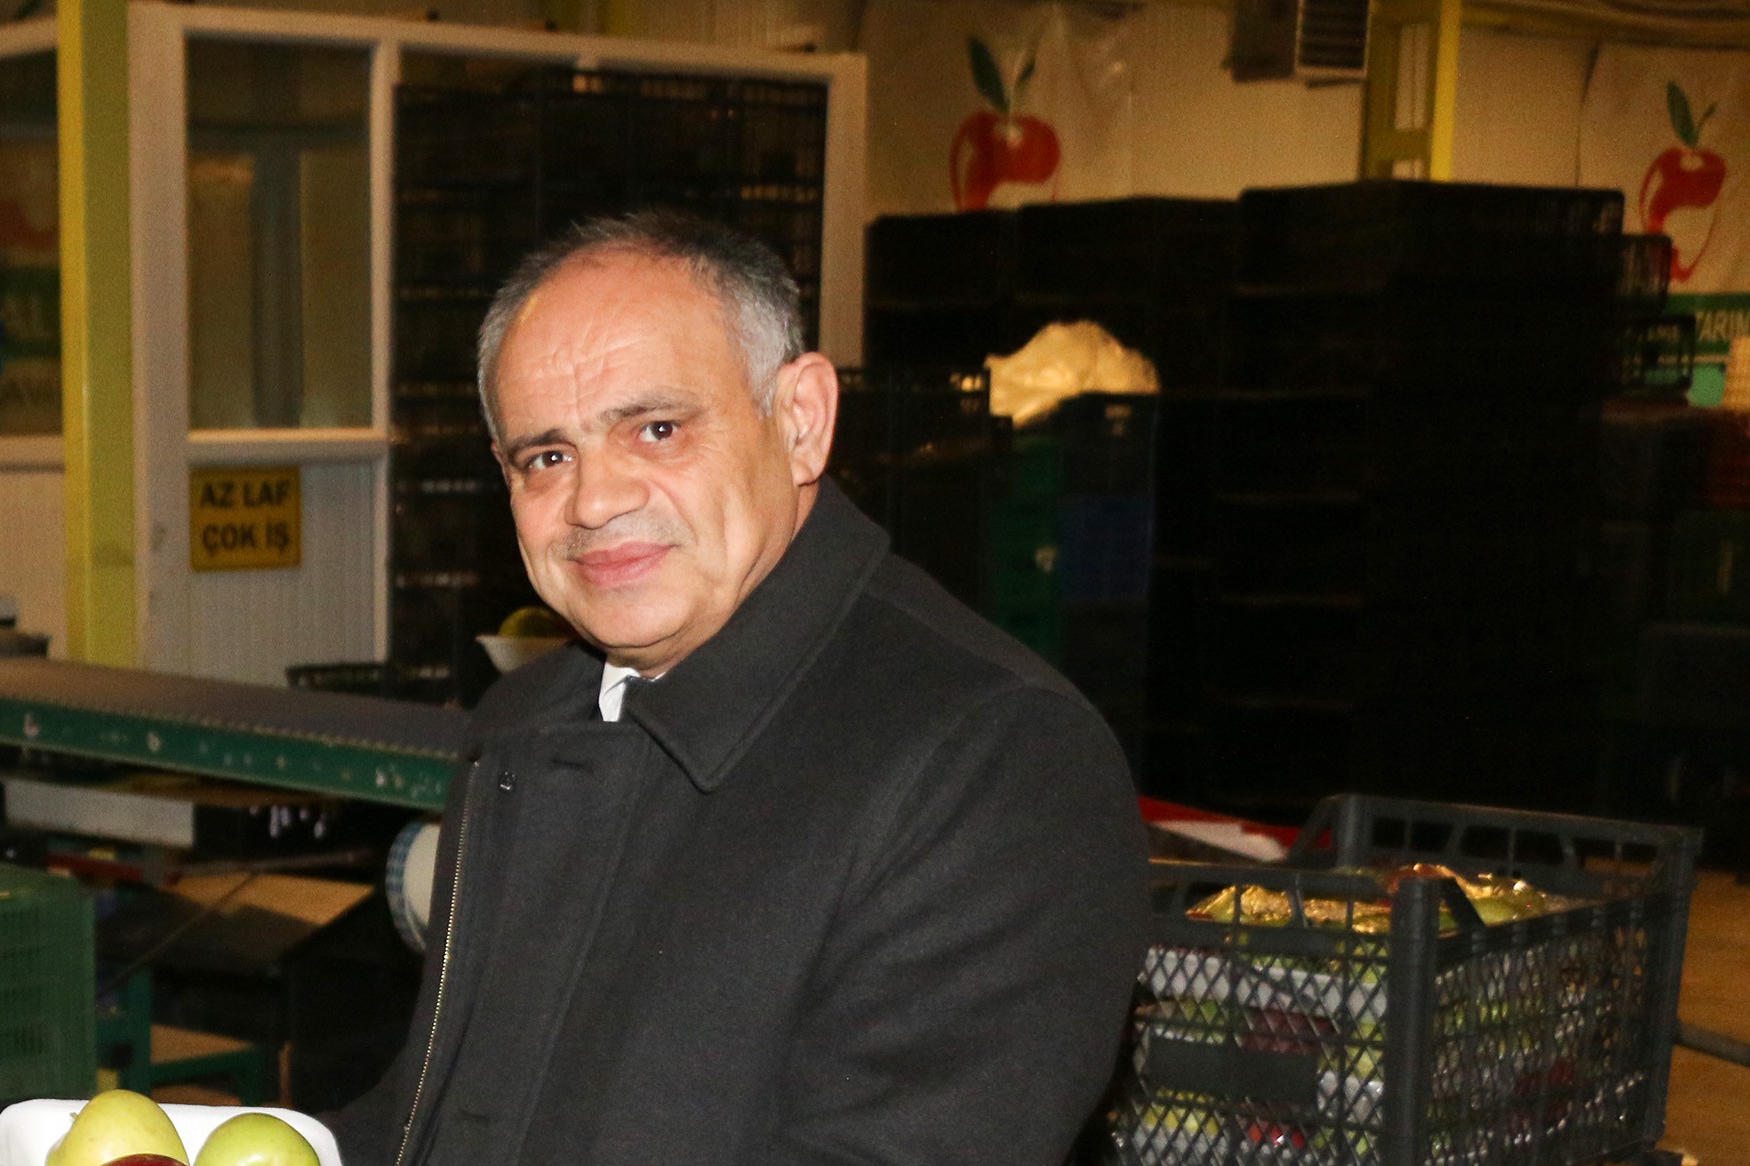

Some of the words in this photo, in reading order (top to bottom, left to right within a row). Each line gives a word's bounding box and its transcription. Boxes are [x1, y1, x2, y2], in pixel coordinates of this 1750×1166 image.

[201, 481, 234, 508] AZ
[243, 480, 290, 508] LAF
[203, 522, 256, 556] ÇOK
[266, 517, 291, 555] İŞ
